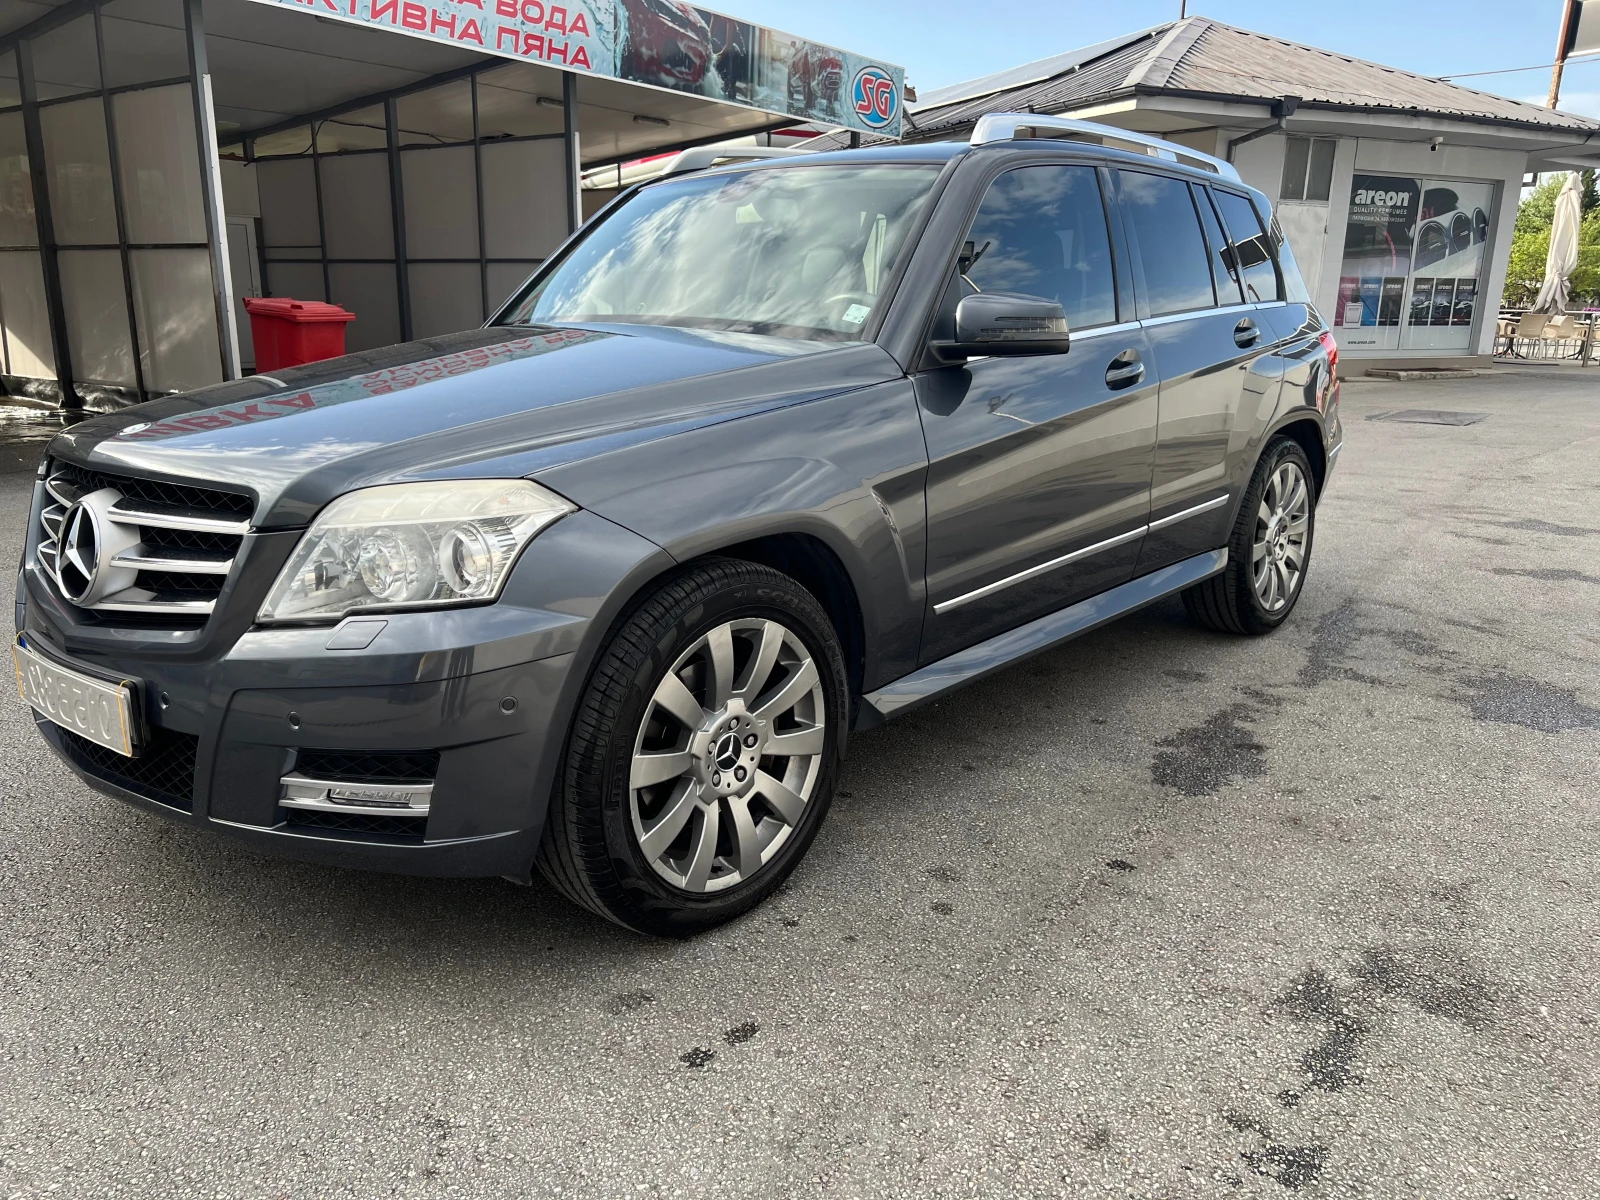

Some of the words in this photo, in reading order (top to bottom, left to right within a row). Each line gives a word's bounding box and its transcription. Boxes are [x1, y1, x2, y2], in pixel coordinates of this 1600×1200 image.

[296, 0, 484, 45] ТИВНА
[496, 25, 591, 69] ПЯНА
[495, 0, 590, 37] ВОДА
[856, 74, 893, 119] SG
[1353, 206, 1377, 214] QUALITY
[1354, 189, 1409, 206] areon
